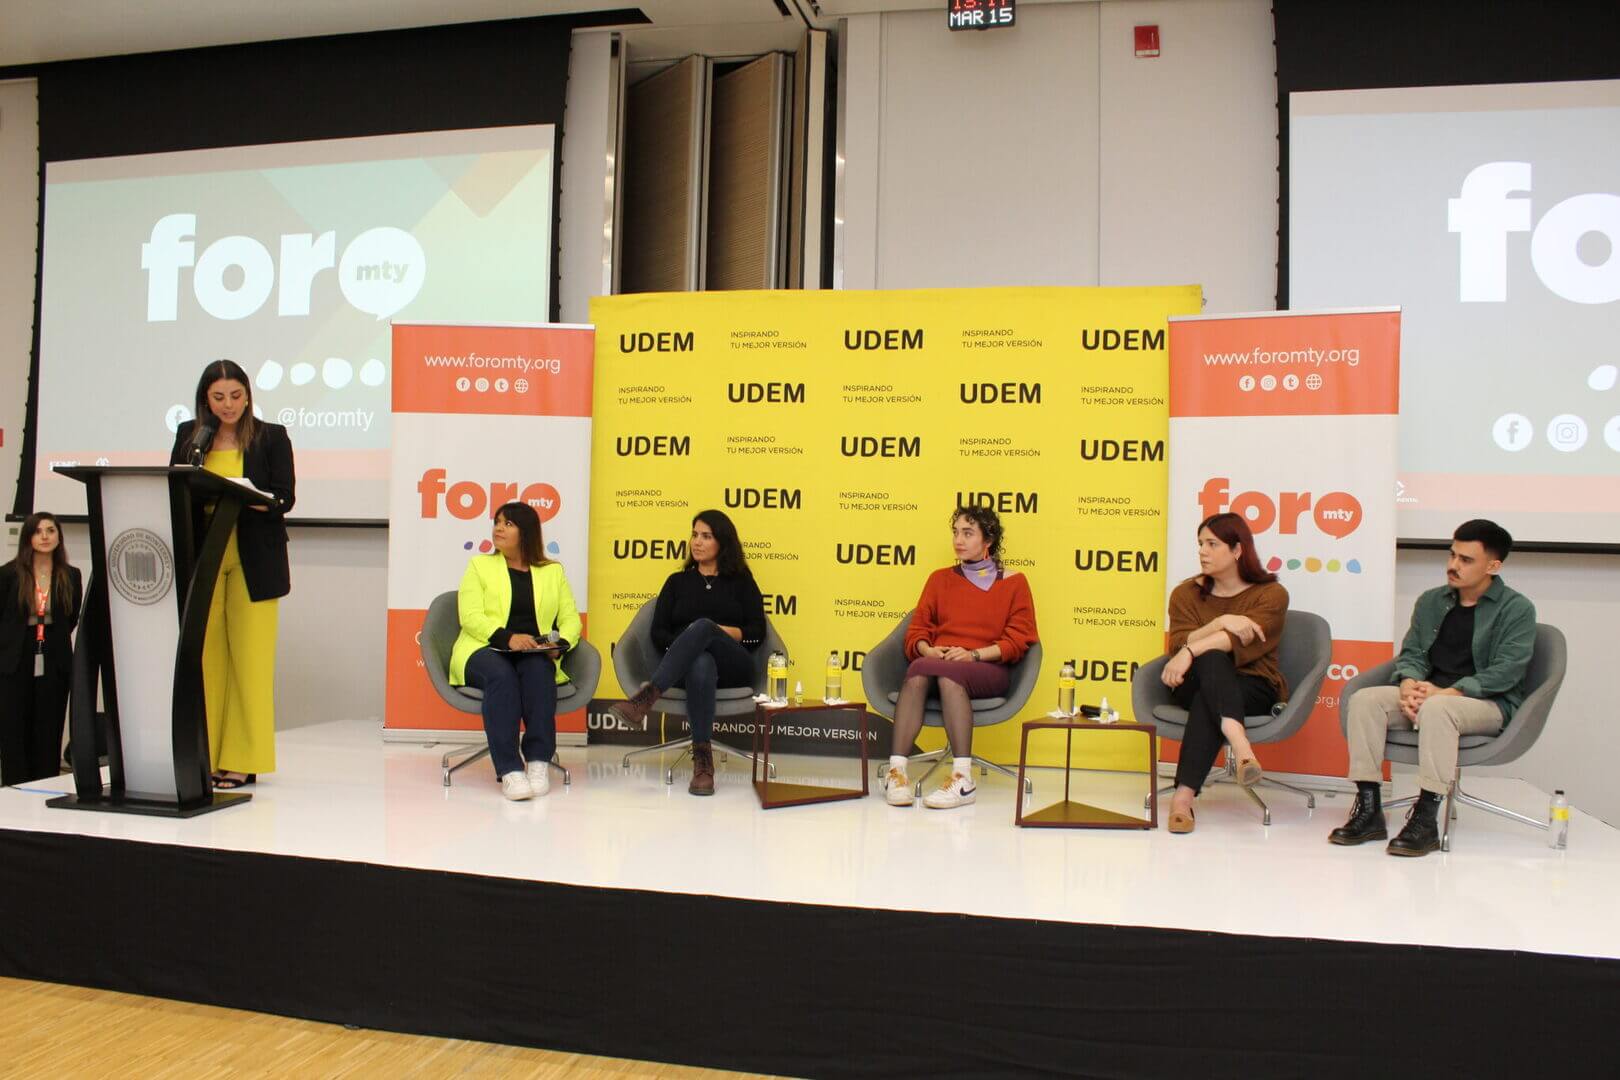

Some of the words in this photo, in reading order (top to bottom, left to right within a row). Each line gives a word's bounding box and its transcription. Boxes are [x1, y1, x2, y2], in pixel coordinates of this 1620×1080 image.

[949, 10, 984, 27] MAR
[990, 7, 1013, 24] 15
[1448, 161, 1620, 304] fo
[141, 213, 426, 321] foro
[355, 259, 410, 284] mty
[731, 331, 779, 339] INSPIRANDO
[844, 329, 923, 350] UDEM
[962, 329, 1013, 338] INSPIRANDO
[1082, 329, 1165, 351] UDEM
[620, 331, 694, 353] UDEM
[731, 341, 740, 349] TU
[742, 341, 770, 349] MEJOR
[773, 340, 807, 349] VERSIÓN
[962, 340, 970, 348] TU
[972, 339, 1002, 348] MEJOR
[1005, 338, 1042, 347] VERSIÓN
[424, 353, 561, 374] www.foromty.org
[1204, 347, 1360, 366] www.foromty.org
[618, 386, 665, 394] INSPIRANDO
[728, 382, 805, 403] UDEM
[843, 384, 893, 392] INSPIRANDO
[960, 383, 1041, 404] UDEM
[1081, 386, 1133, 394] INSPIRANDO
[618, 397, 628, 405] TU
[659, 395, 692, 403] VERSIÓN
[843, 395, 852, 403] TU
[855, 394, 882, 403] MEJOR
[885, 394, 921, 403] VERSIÓN
[1081, 397, 1092, 405] TU
[1094, 397, 1124, 405] MEJOR
[1127, 397, 1164, 406] VERSIÓN
[278, 408, 374, 431] @foromty
[616, 436, 690, 456] UDEM
[841, 436, 920, 457] UDEM
[959, 437, 1011, 446] INSPIRANDO
[769, 446, 804, 455] VERSIÓN
[959, 448, 969, 456] TU
[971, 448, 1001, 456] MEJOR
[1004, 448, 1040, 456] VERSIÓN
[1080, 439, 1164, 461] UDEM
[417, 468, 561, 524] foro
[616, 490, 661, 498] INSPIRANDO
[725, 488, 801, 510] UDEM
[839, 491, 889, 500] INSPIRANDO
[528, 497, 553, 509] mty
[656, 499, 688, 507] VERSIÓN
[851, 503, 879, 511] MEJOR
[881, 502, 917, 511] VERSIÓN
[956, 492, 1038, 513] UDEM
[1198, 477, 1363, 540] foro
[1078, 507, 1088, 516] TU
[1090, 507, 1120, 517] MEJOR
[1122, 507, 1160, 517] VERSIÓN
[1322, 507, 1354, 522] mty
[614, 540, 687, 560] UDEM
[764, 552, 799, 560] VERSIÓN
[836, 543, 915, 565] UDEM
[1075, 549, 1158, 572] UDEM
[762, 594, 797, 616] EM
[835, 599, 885, 608] INSPIRANDO
[1073, 607, 1126, 615] INSPIRANDO
[847, 610, 875, 618] MEJOR
[1073, 617, 1084, 625] TU
[1086, 618, 1116, 626] MEJOR
[1119, 618, 1156, 627] VERSIÓN
[681, 720, 756, 734] INRANDO
[777, 725, 821, 738] MEJOR
